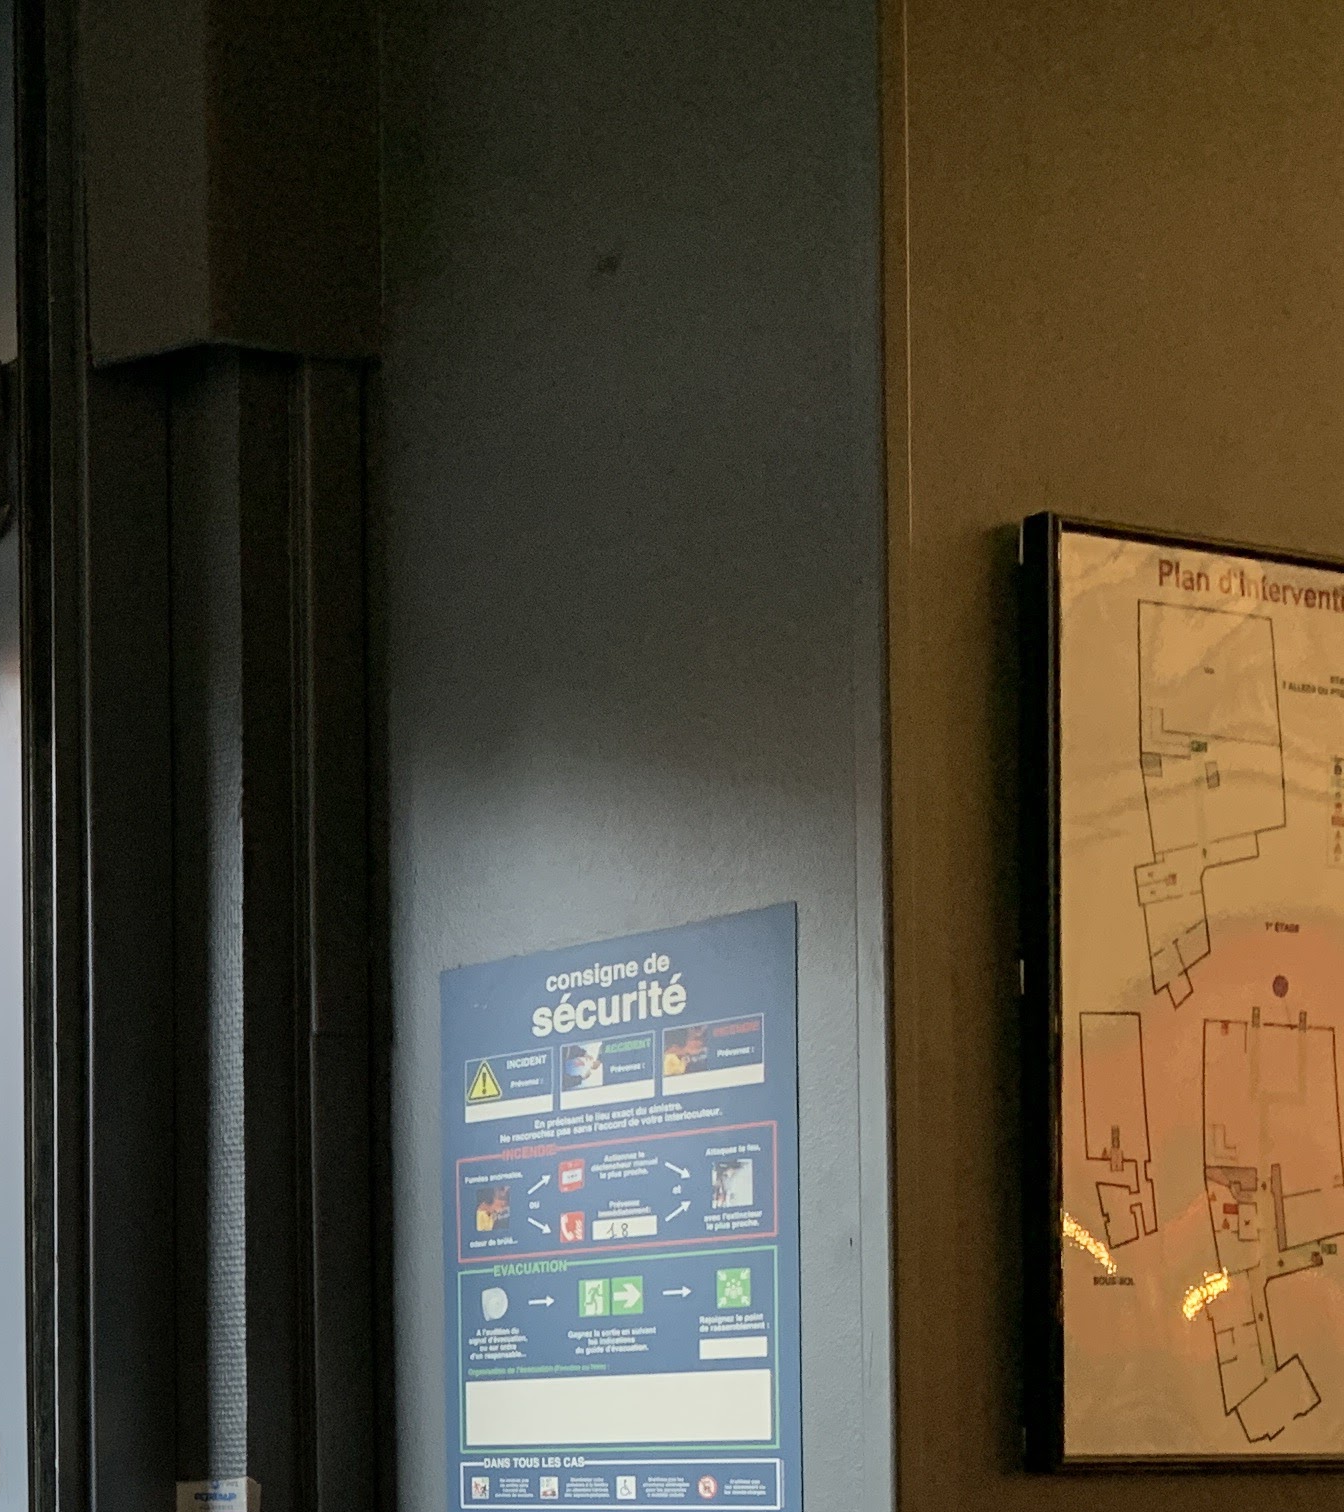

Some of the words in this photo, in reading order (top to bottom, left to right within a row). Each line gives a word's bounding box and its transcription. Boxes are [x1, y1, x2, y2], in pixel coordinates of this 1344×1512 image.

[1158, 559, 1209, 591] Plan
[546, 960, 638, 992] consigne
[644, 952, 670, 974] de
[532, 973, 687, 1038] sécurité
[507, 1054, 547, 1069] INCIDENT
[493, 1261, 567, 1277] EVACUATION
[483, 1458, 510, 1468] DANS
[513, 1457, 539, 1468] TOUS
[542, 1457, 561, 1468] LES
[563, 1456, 585, 1467] CAS
